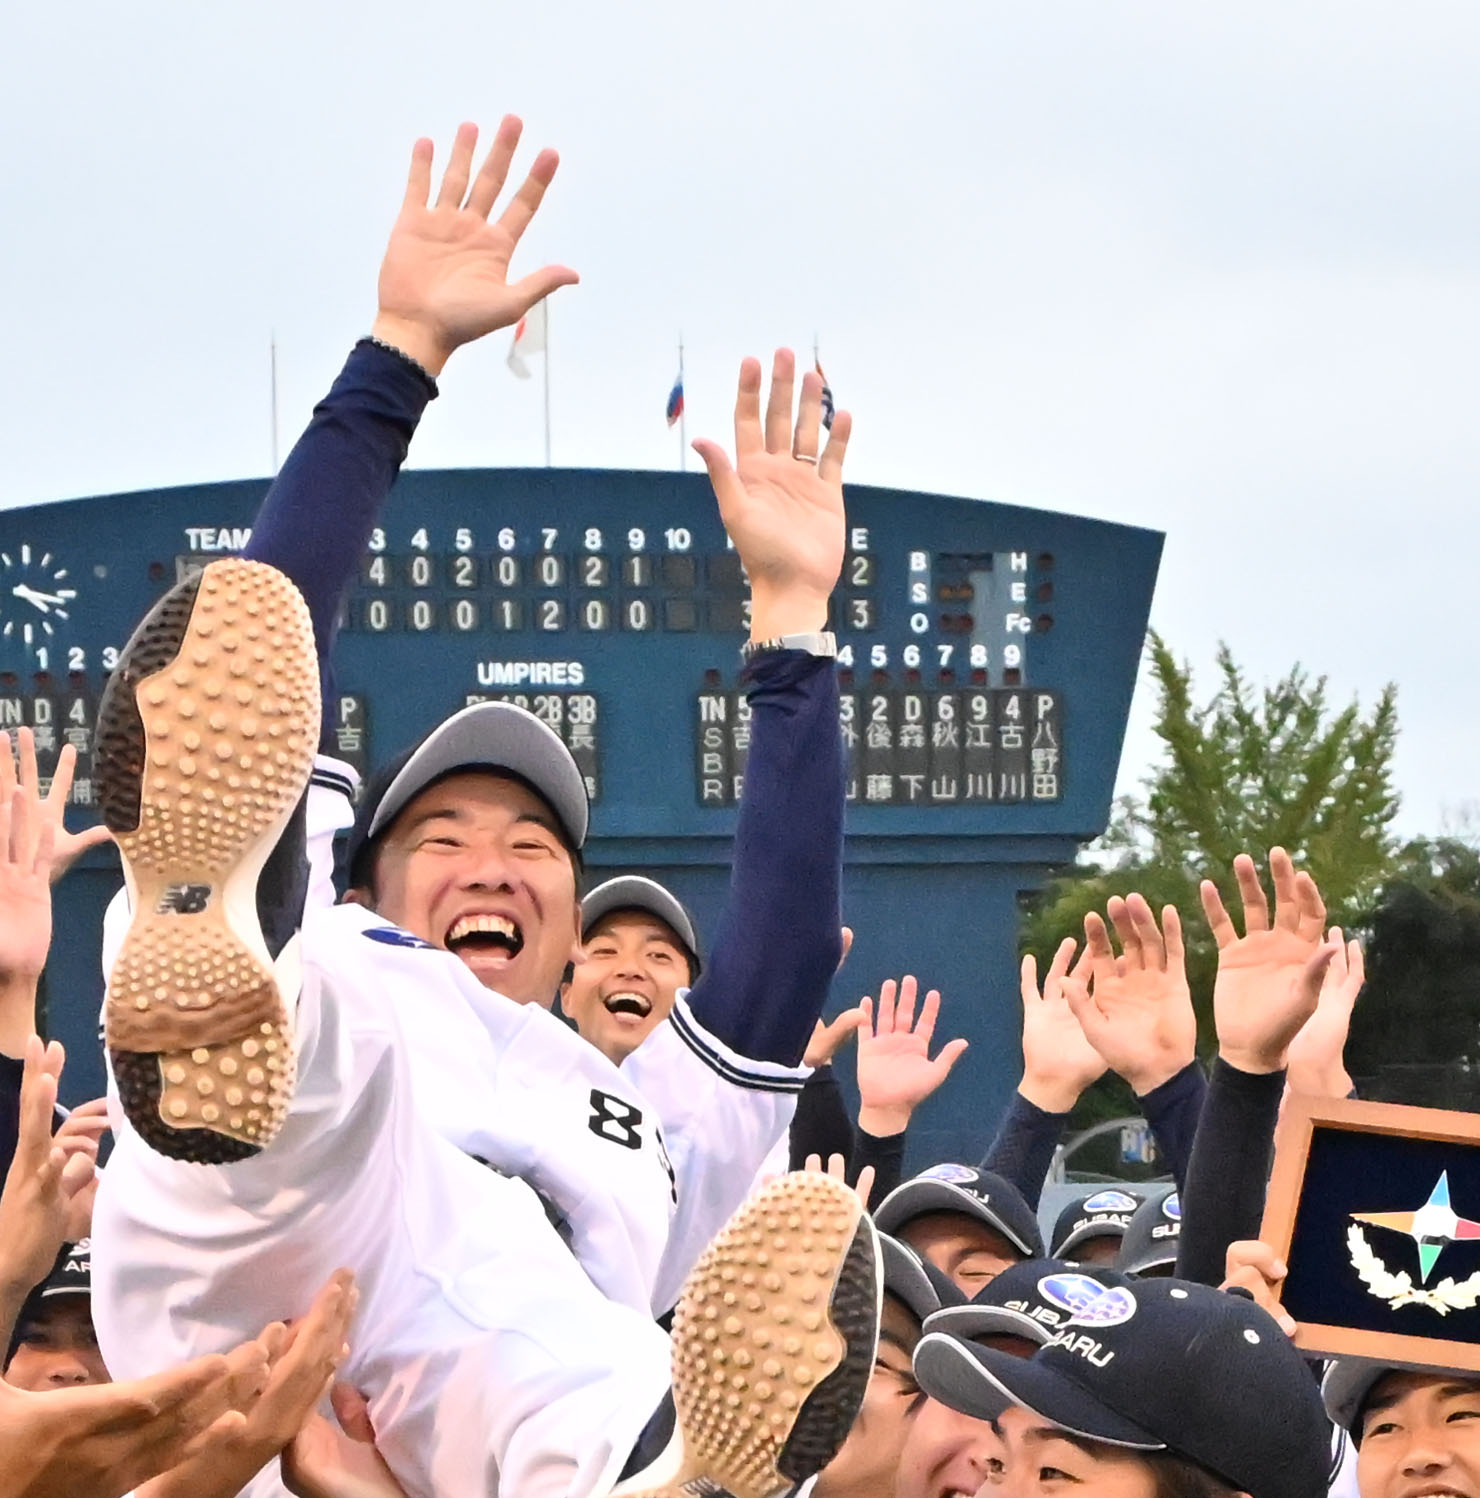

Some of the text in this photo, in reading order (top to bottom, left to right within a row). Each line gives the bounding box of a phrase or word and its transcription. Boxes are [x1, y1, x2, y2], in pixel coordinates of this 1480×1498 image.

[368, 528, 387, 551] 3
[411, 528, 430, 551] 4
[455, 528, 473, 551] 5
[497, 528, 516, 551] 6
[541, 528, 558, 551] 7
[584, 528, 603, 551] 8
[627, 528, 646, 551] 9
[664, 528, 691, 550] 10
[851, 528, 869, 550] E
[369, 556, 869, 587] 4 0 2 0 0 2 1 2
[910, 551, 928, 571] B
[1010, 551, 1028, 571] H
[911, 582, 928, 604] S
[1010, 582, 1027, 602] E
[370, 600, 387, 630] 0
[413, 600, 431, 630] 0
[456, 600, 474, 630] 0
[502, 600, 512, 630] 1
[542, 600, 560, 630] 2
[586, 600, 604, 630] 0
[628, 600, 647, 630] 0
[852, 600, 870, 629] 3
[1005, 612, 1032, 634] Fc
[35, 646, 120, 670] 1 2 3
[837, 644, 1021, 667] 4 5 6 7 8 9
[476, 661, 585, 686] UMPIRES
[69, 697, 85, 724] 4
[340, 696, 357, 722] P
[568, 694, 597, 724] 3B
[839, 695, 854, 721] 3
[871, 695, 888, 721] 2
[905, 695, 921, 721] D
[938, 695, 954, 721] 6
[971, 695, 987, 721] 9
[1005, 695, 1020, 721] 4
[1037, 695, 1054, 720] P
